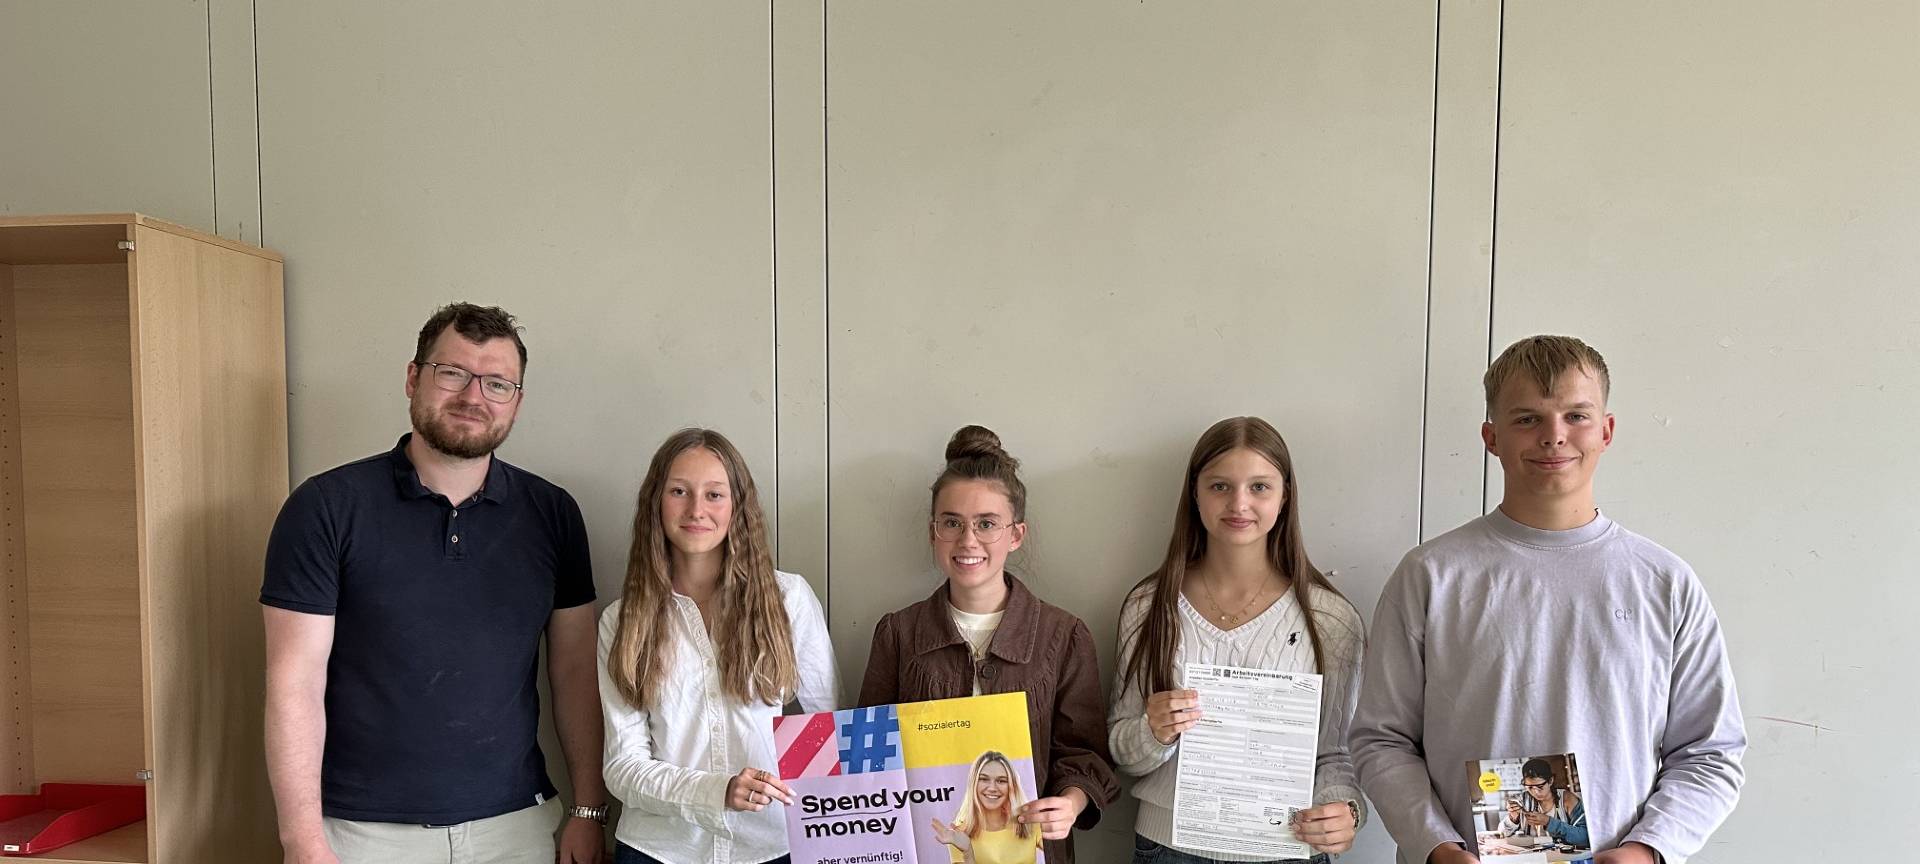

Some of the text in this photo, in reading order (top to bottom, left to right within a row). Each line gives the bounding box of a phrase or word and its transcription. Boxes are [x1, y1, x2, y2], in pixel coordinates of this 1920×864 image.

[917, 719, 971, 731] #sozialertag
[801, 786, 955, 815] Spend your
[805, 817, 897, 838] money
[844, 850, 904, 864] vernünftig!
